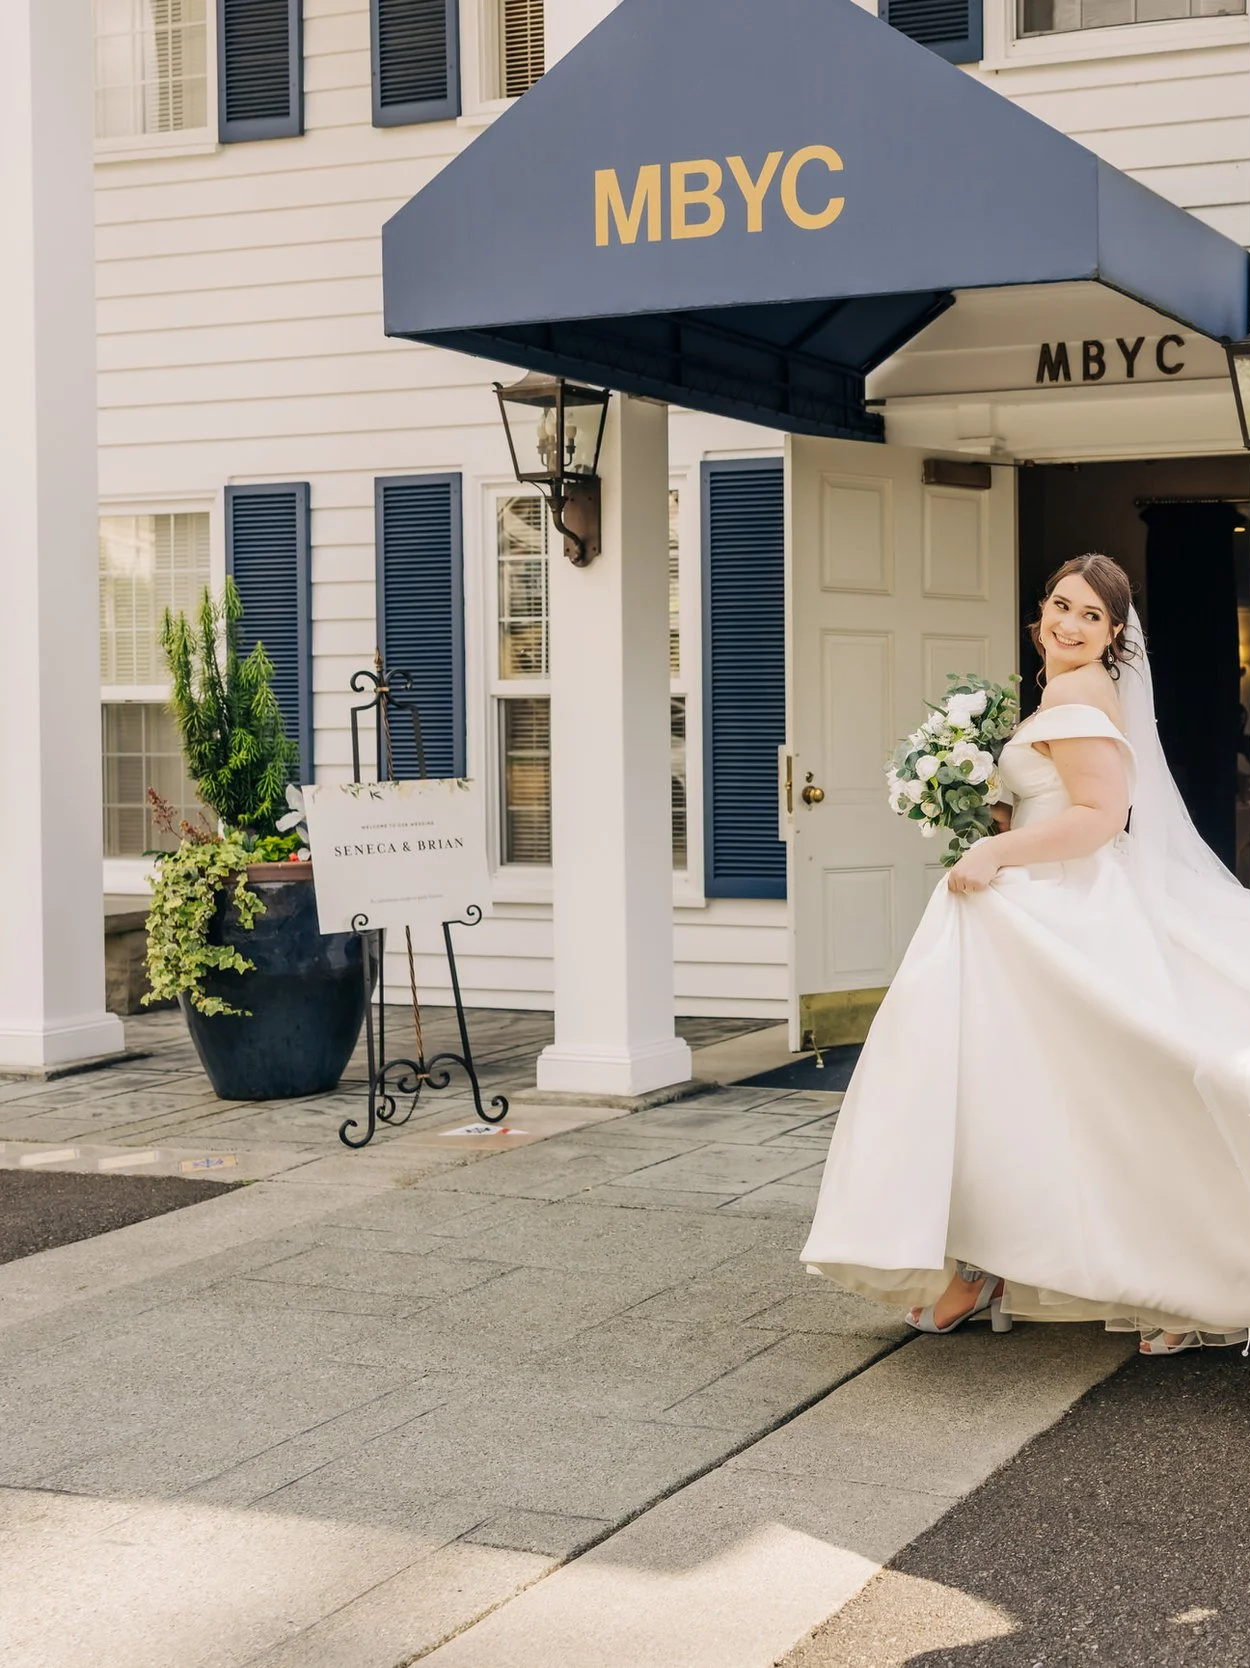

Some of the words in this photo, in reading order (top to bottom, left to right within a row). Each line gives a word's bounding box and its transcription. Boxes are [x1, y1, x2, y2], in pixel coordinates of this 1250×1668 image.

[595, 144, 845, 247] MBYC
[1036, 334, 1185, 383] MBYC
[334, 842, 397, 857] SENECA
[402, 841, 412, 852] &
[417, 837, 464, 851] BRIAN
